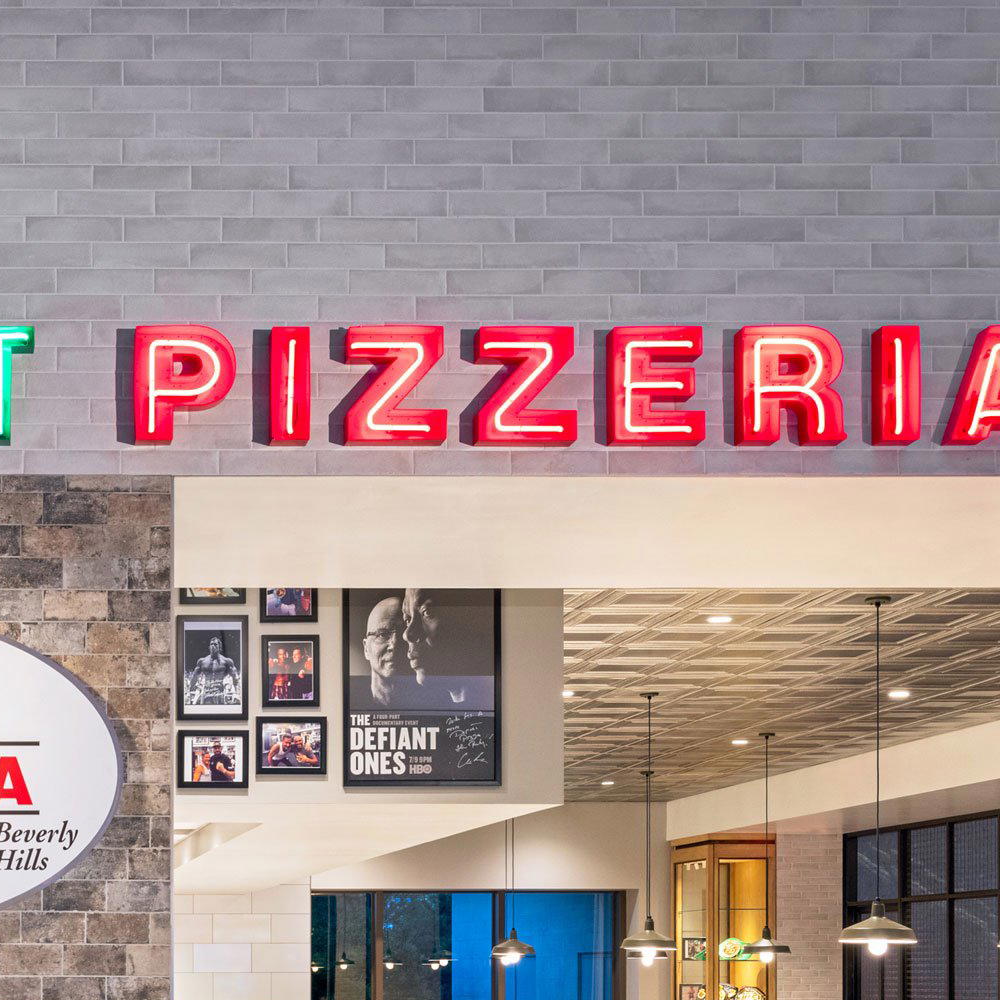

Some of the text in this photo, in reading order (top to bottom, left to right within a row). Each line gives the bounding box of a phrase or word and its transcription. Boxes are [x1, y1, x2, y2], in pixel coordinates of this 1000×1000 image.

[350, 714, 371, 726] THE
[350, 727, 440, 750] DEFIANT
[350, 751, 406, 776] ONES
[409, 764, 433, 775] HBO
